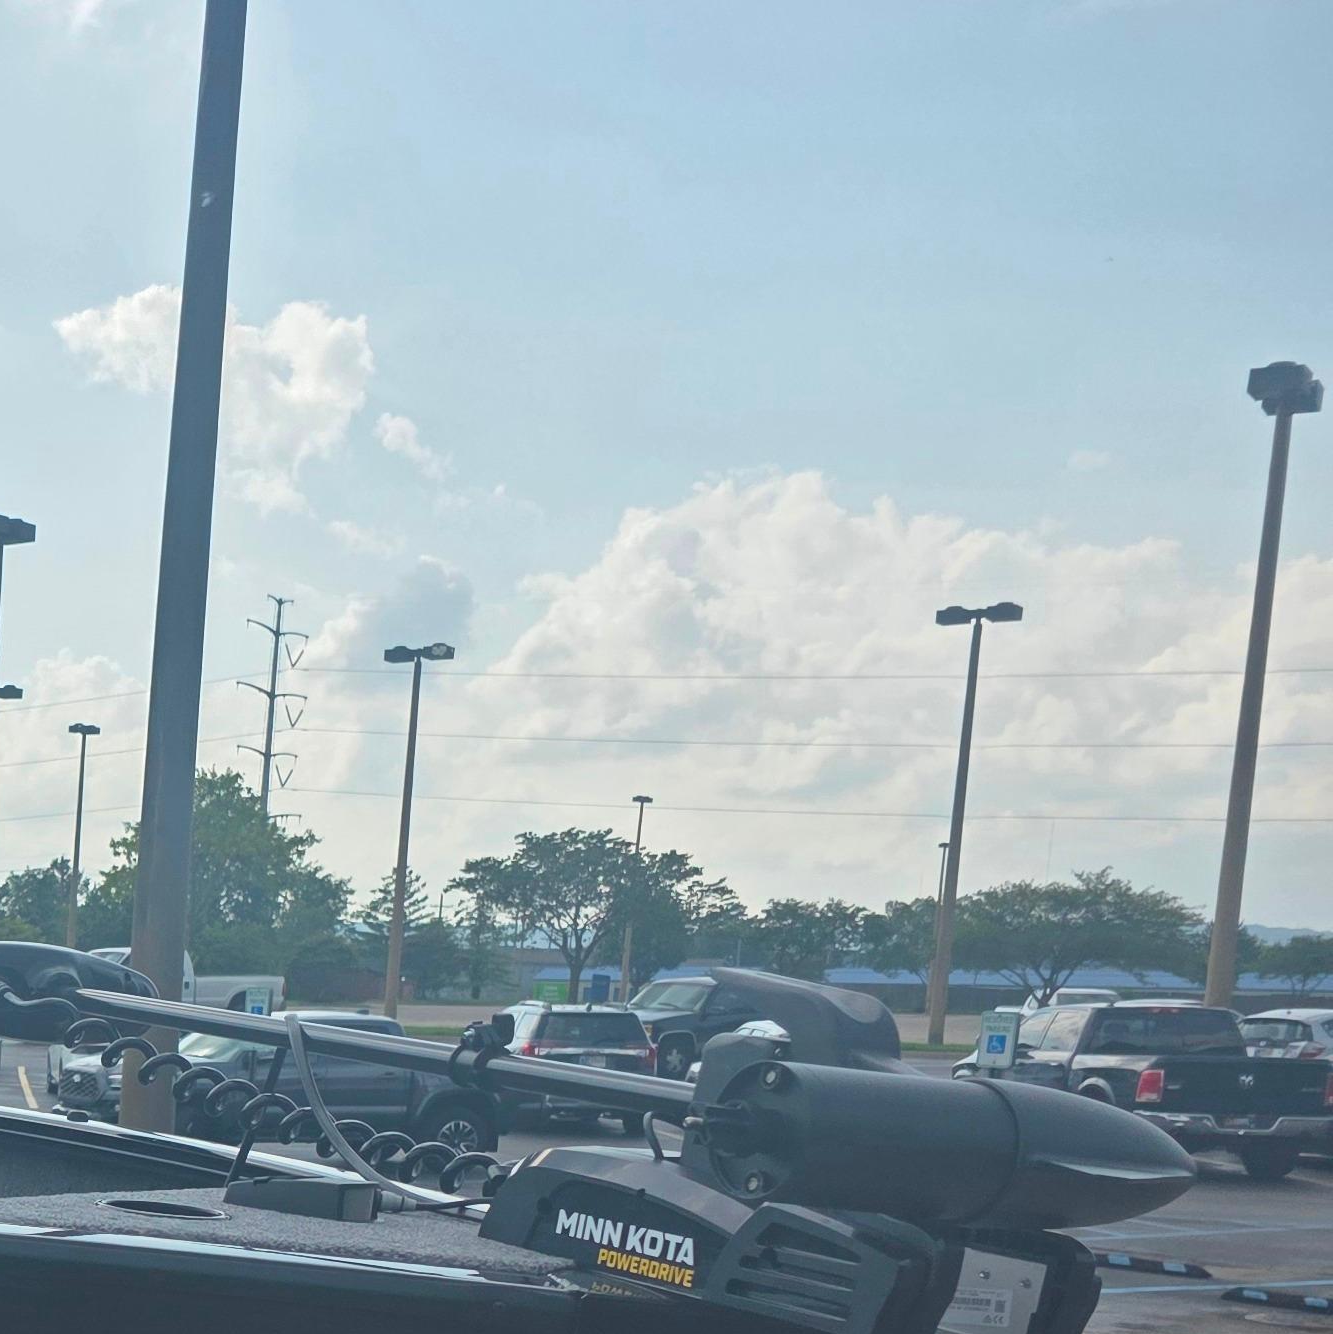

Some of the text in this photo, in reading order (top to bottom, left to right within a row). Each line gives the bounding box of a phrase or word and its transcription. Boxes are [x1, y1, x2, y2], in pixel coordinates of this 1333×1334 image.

[555, 1208, 695, 1267] MINN KOTA
[597, 1248, 695, 1288] POWERDRIVE
